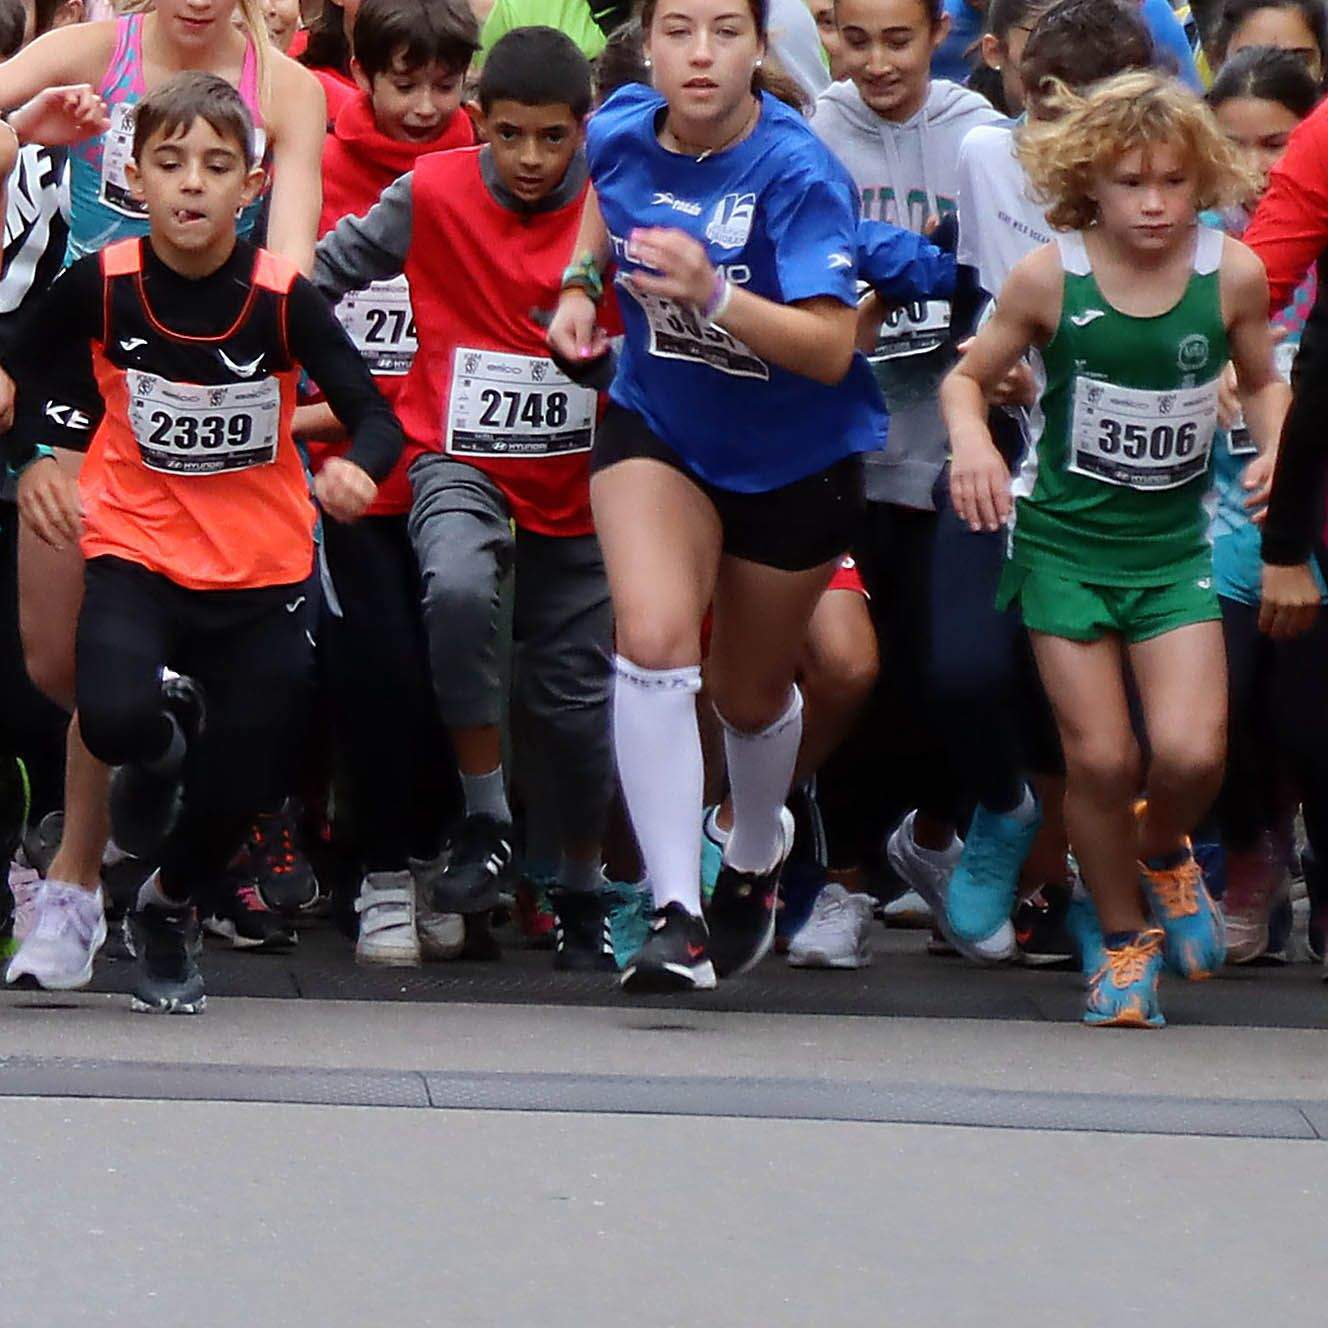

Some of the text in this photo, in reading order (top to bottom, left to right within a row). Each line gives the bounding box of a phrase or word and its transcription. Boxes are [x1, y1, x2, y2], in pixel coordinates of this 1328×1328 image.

[478, 388, 569, 429] 2748
[148, 410, 254, 450] 2339
[1097, 418, 1198, 462] 3506
